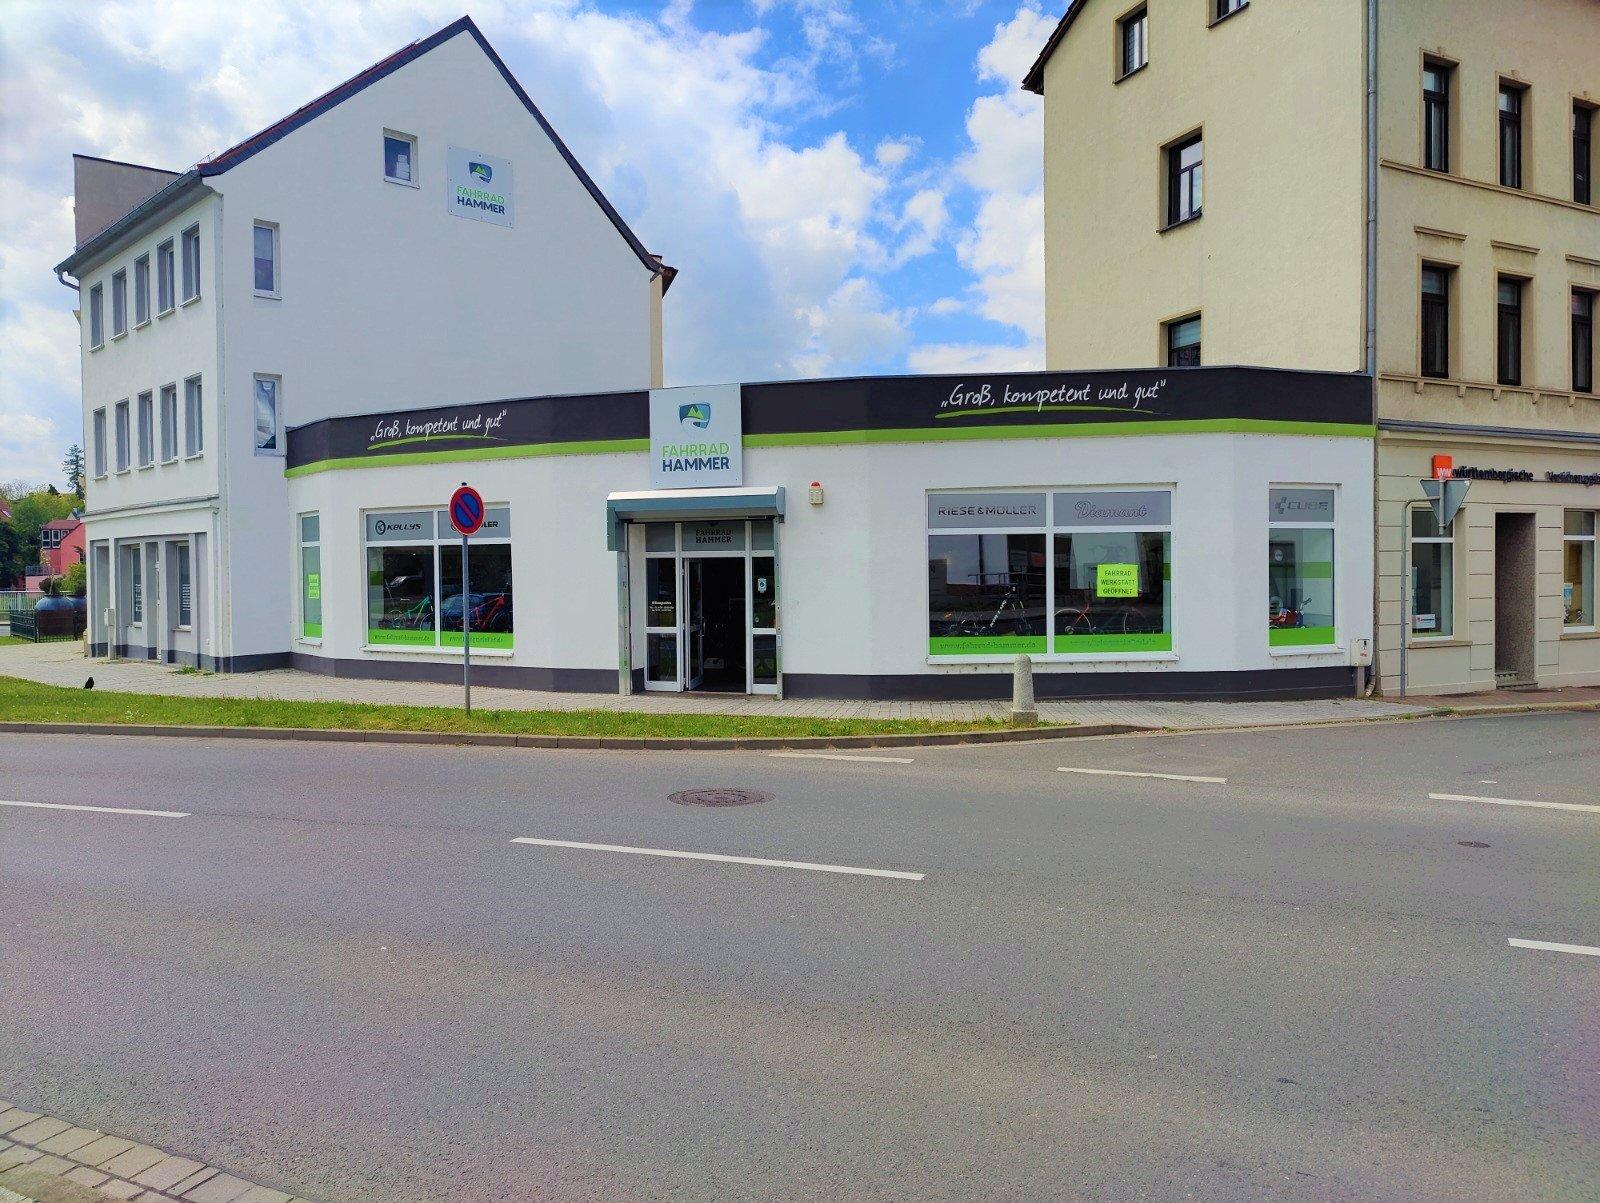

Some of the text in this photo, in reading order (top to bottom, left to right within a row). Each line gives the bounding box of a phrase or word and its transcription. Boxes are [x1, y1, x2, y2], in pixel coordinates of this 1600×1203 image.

[457, 185, 505, 205] FAHRRAD
[457, 196, 505, 215] HAMMER
[1003, 384, 1091, 412] kompetent
[1098, 382, 1128, 401] und
[405, 416, 458, 441] kompetent
[462, 414, 482, 430] und
[662, 442, 730, 457] FAHRRAD
[662, 456, 730, 472] HAMMER
[938, 505, 975, 516] RIESE
[977, 506, 984, 515] &
[1074, 500, 1148, 519] Diamant
[695, 528, 732, 536] FAHRRAD
[695, 536, 732, 544] HAMMER
